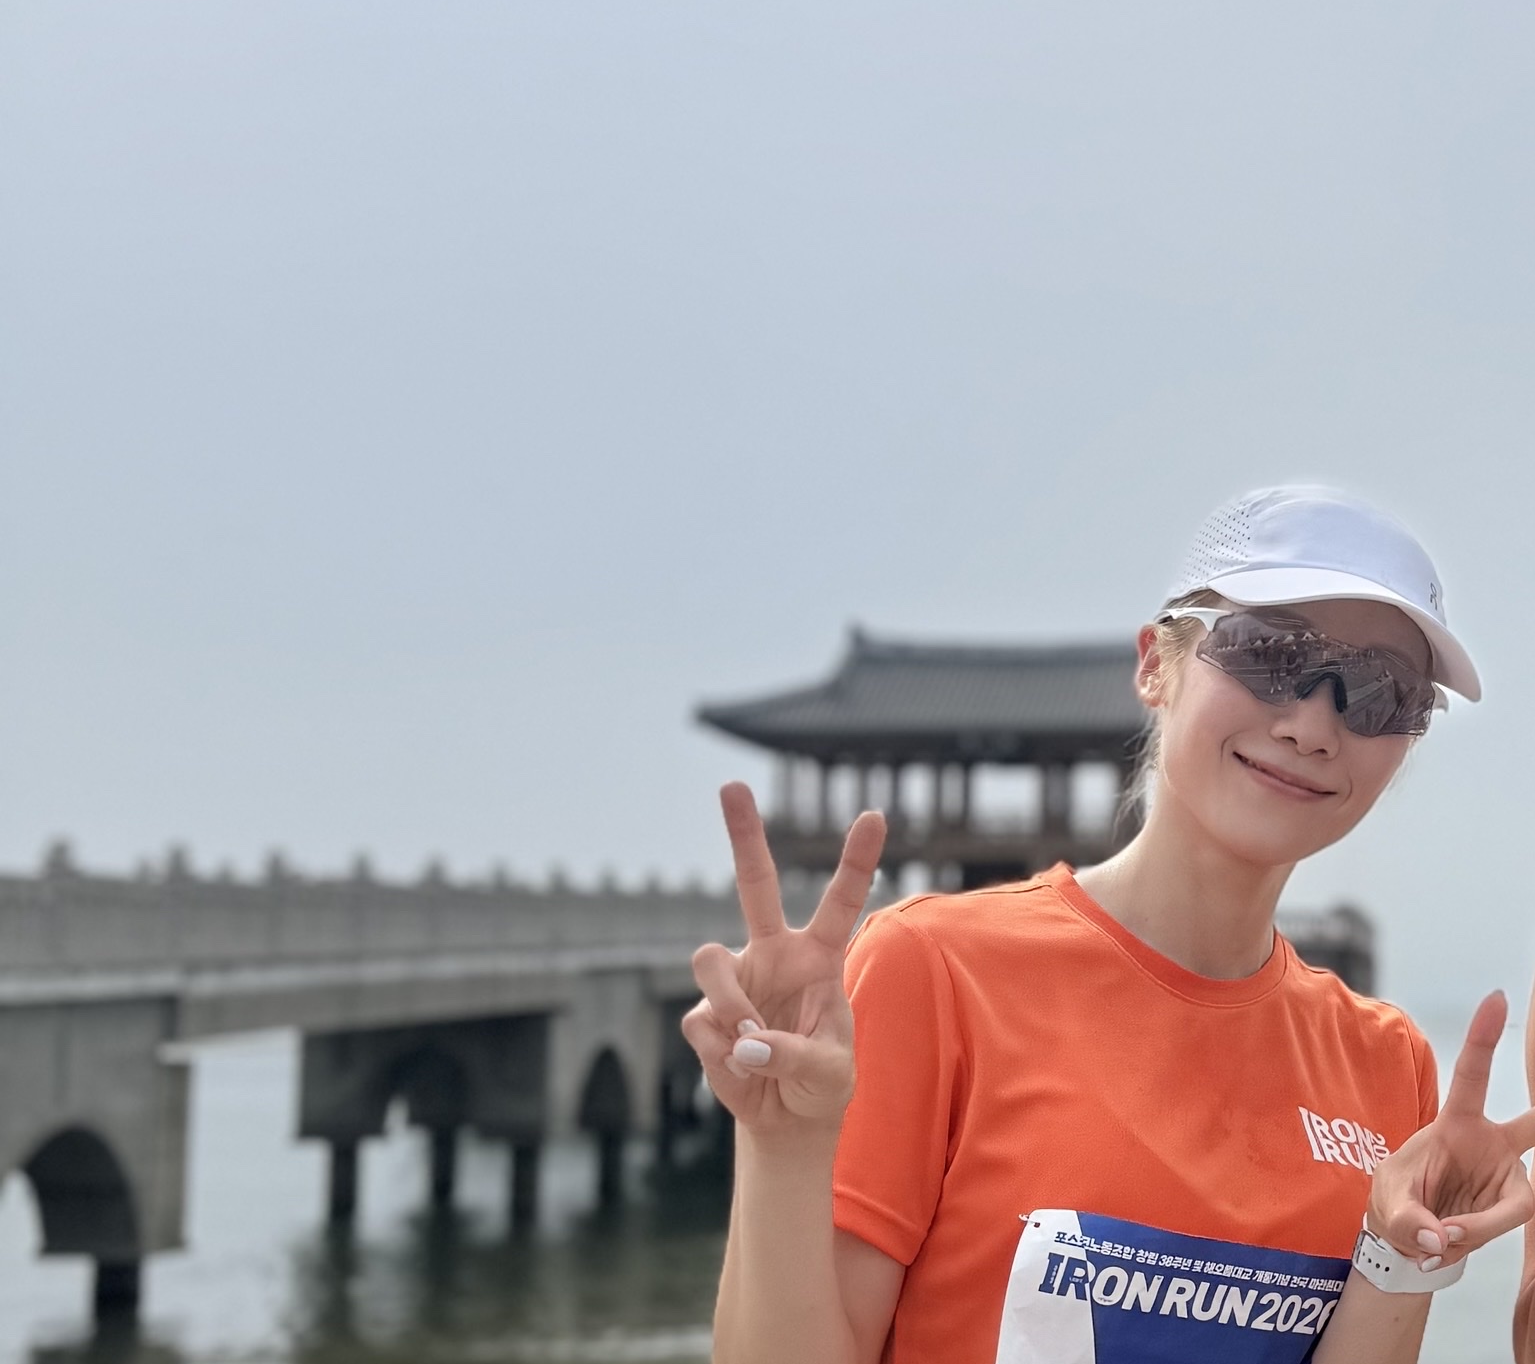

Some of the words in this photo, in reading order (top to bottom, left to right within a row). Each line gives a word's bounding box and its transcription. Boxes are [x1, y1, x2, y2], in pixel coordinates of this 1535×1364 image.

[1038, 1252, 1164, 1313] IRON
[1159, 1277, 1258, 1327] RUN
[1054, 1231, 1136, 1260] 포스코노동조합
[1136, 1249, 1160, 1265] 창립
[1159, 1255, 1193, 1270] 38주년
[1309, 1278, 1344, 1293] 마라톤대
